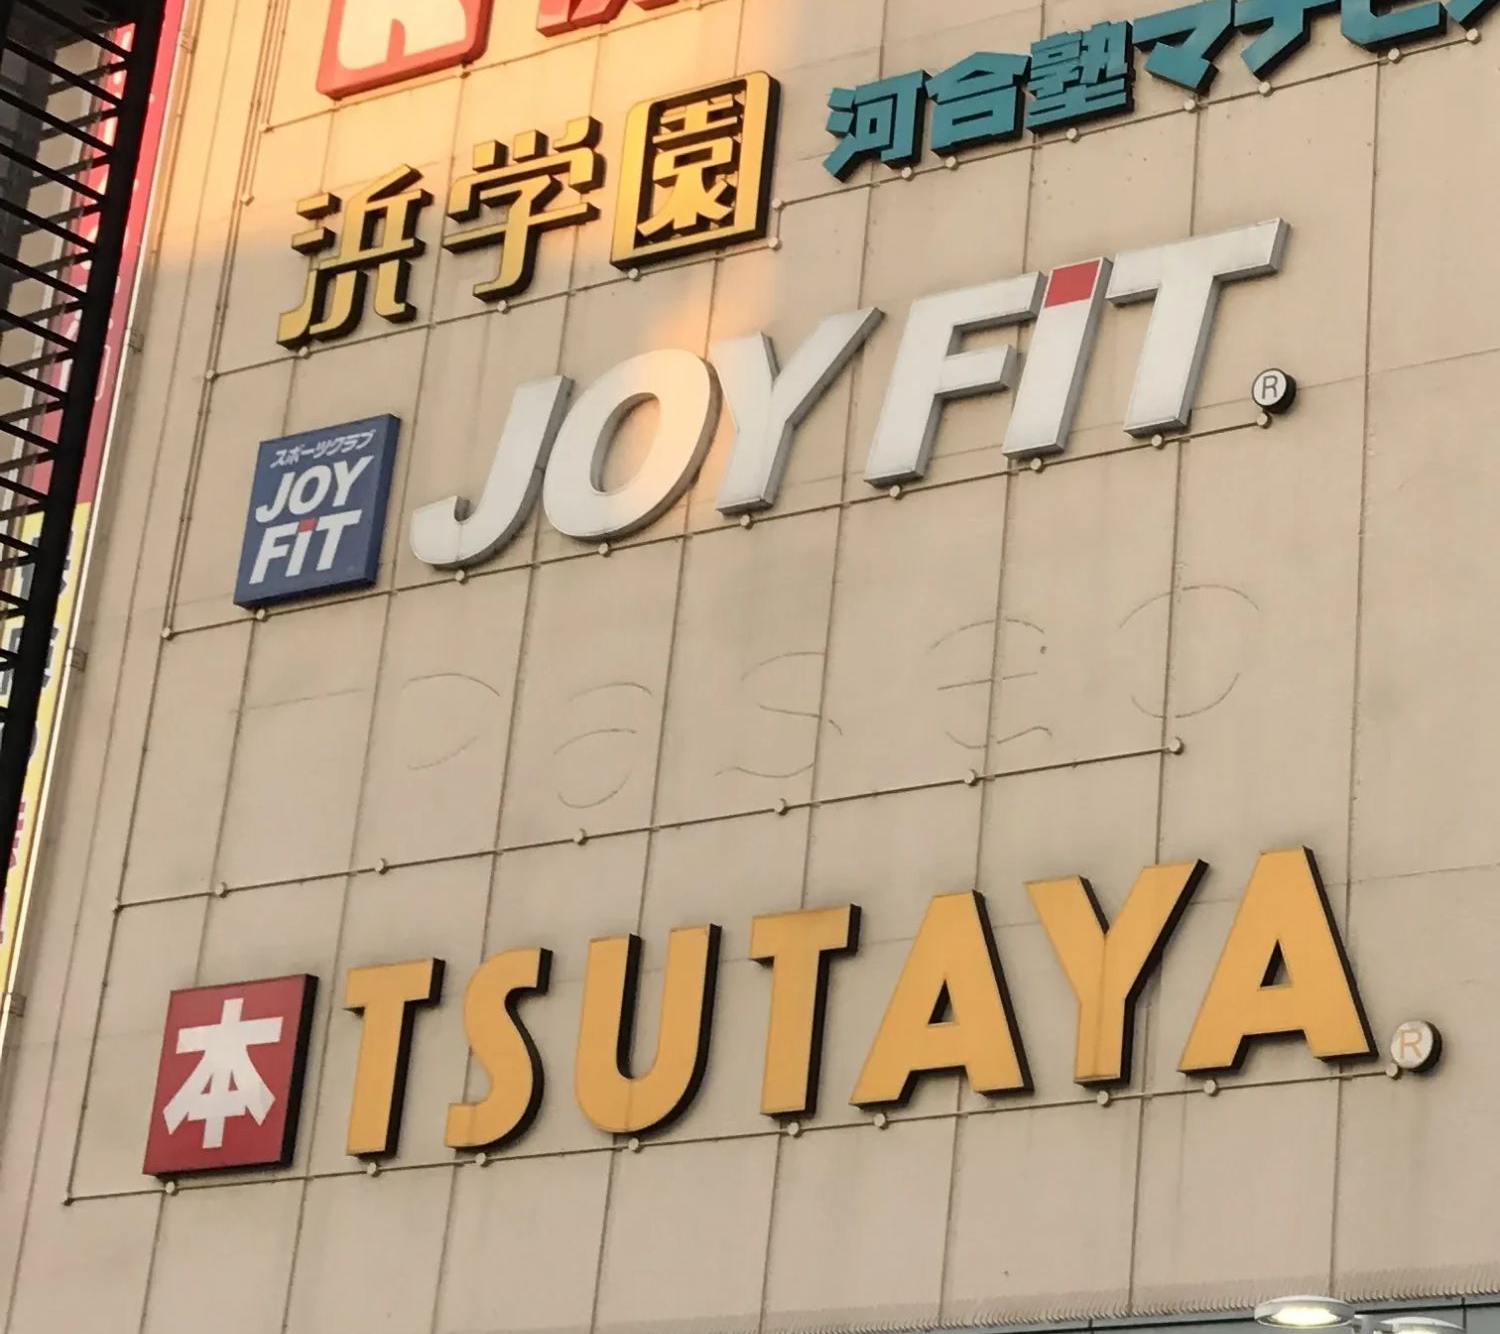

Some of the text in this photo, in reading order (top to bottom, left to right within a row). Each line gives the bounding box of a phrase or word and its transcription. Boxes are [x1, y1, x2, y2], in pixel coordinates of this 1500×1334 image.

[276, 70, 782, 350] 浜学園
[255, 455, 375, 524] JOY
[269, 428, 377, 469] スポーツクラブ
[163, 997, 285, 1150] 本
[342, 845, 1379, 1158] TSUTAYA
